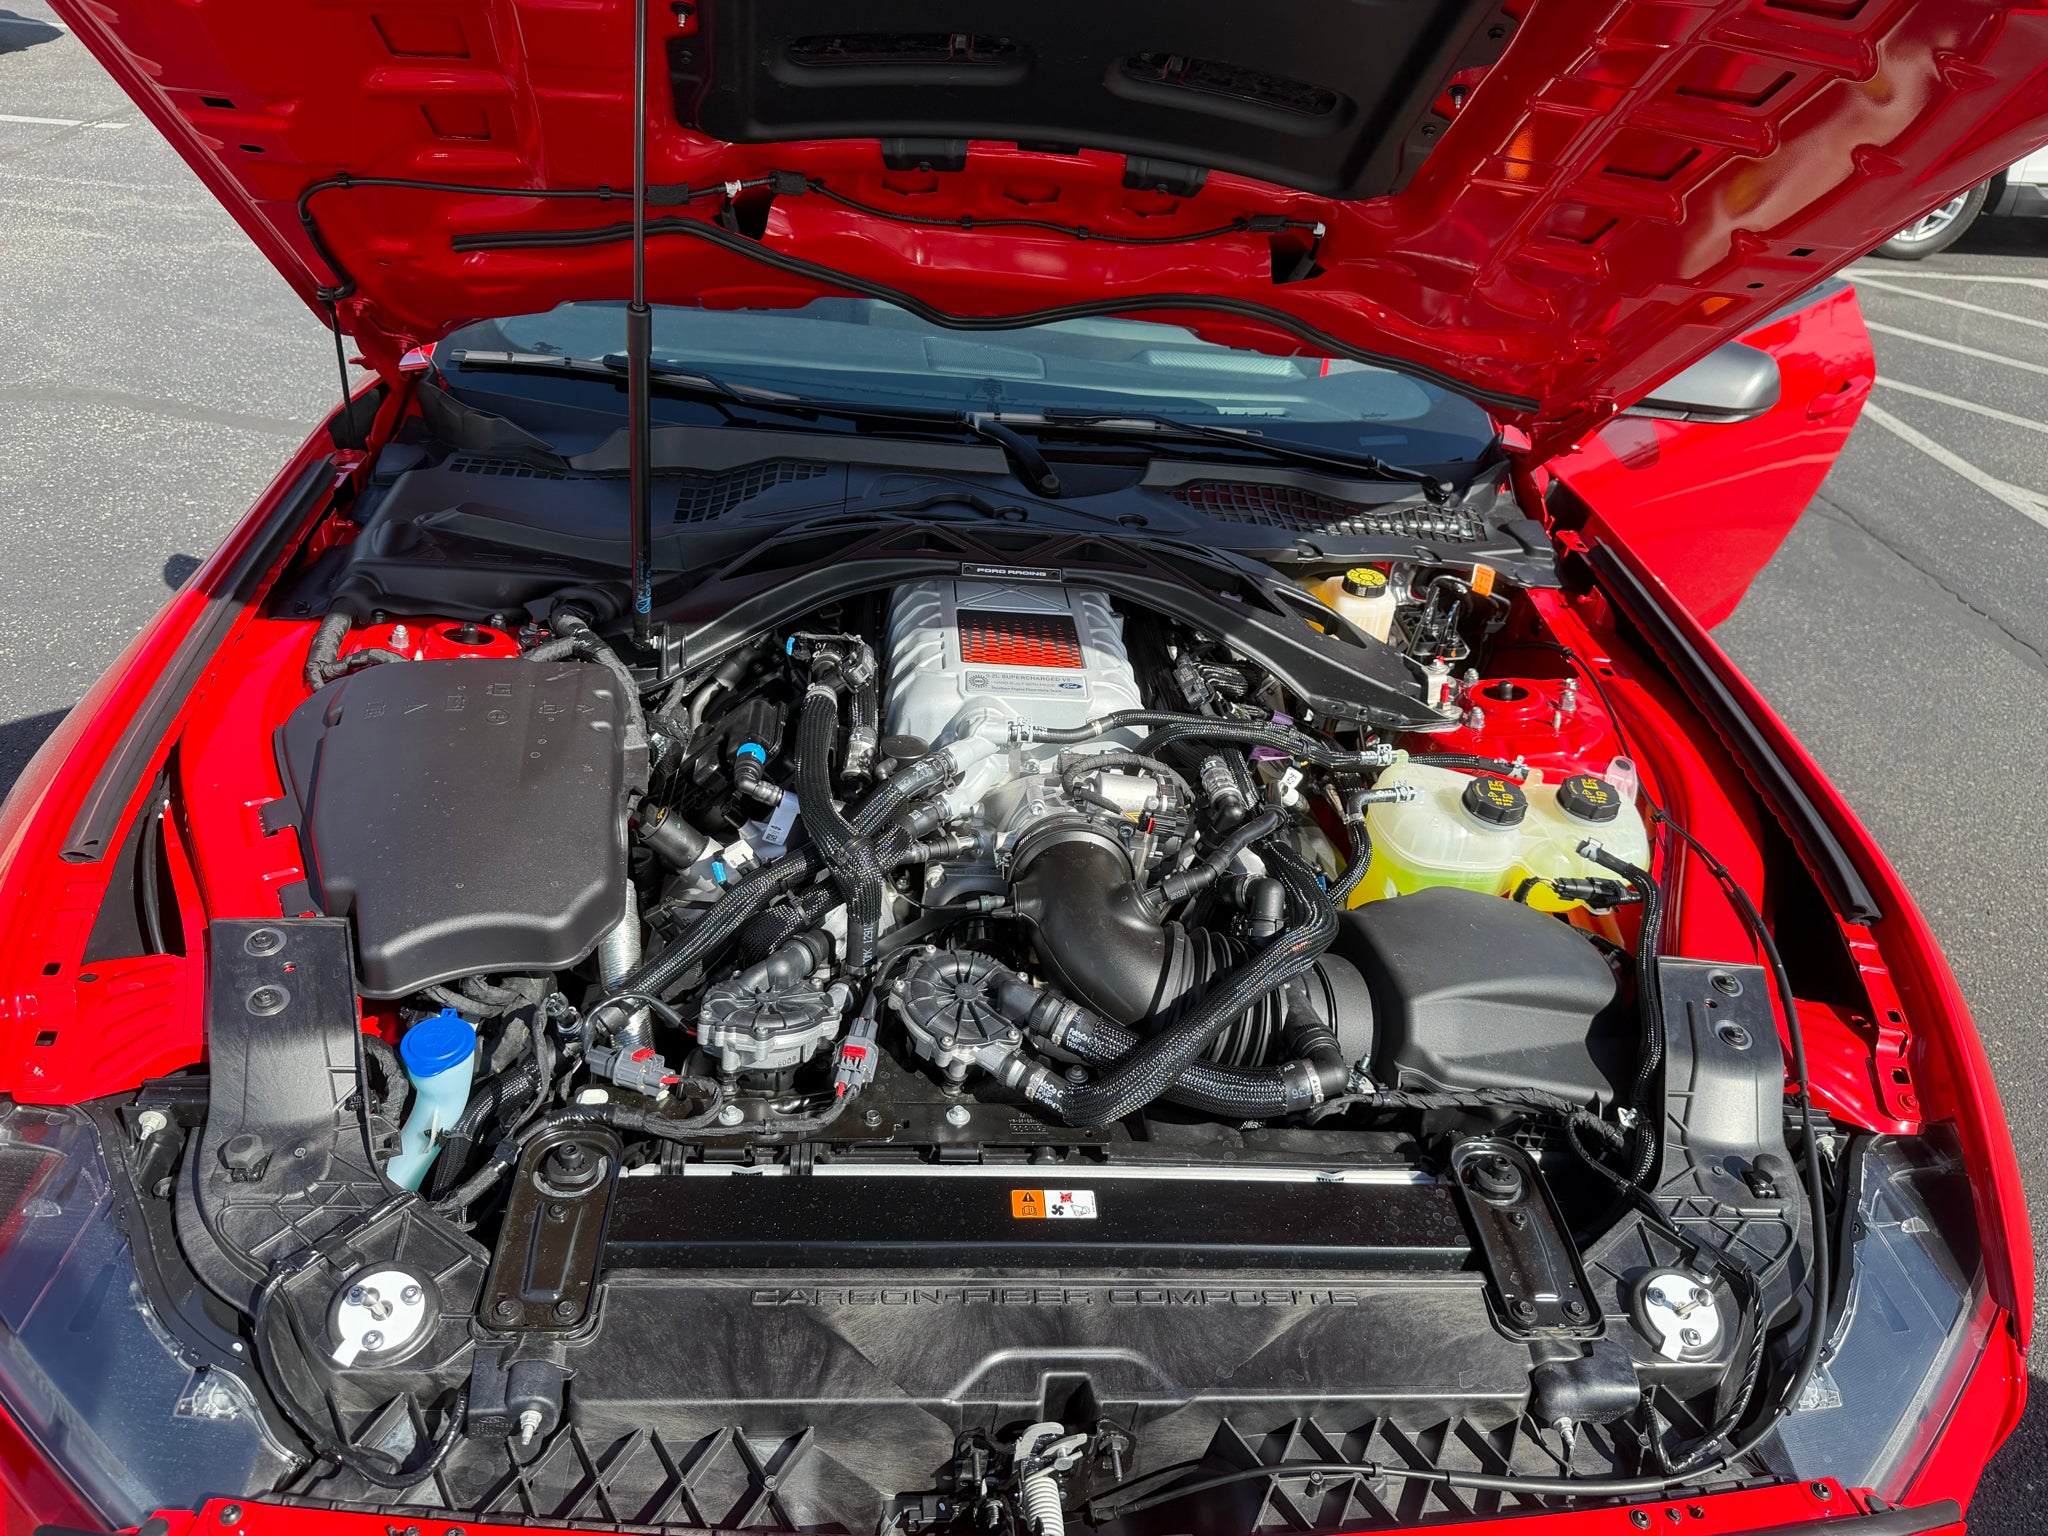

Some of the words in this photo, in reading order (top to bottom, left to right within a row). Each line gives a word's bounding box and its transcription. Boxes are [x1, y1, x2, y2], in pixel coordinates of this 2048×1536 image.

[976, 567, 1006, 575] FORD
[1007, 569, 1047, 577] RACING
[750, 1288, 1094, 1306] CARBON-FIBER
[1108, 1289, 1359, 1307] COMPOSITE
